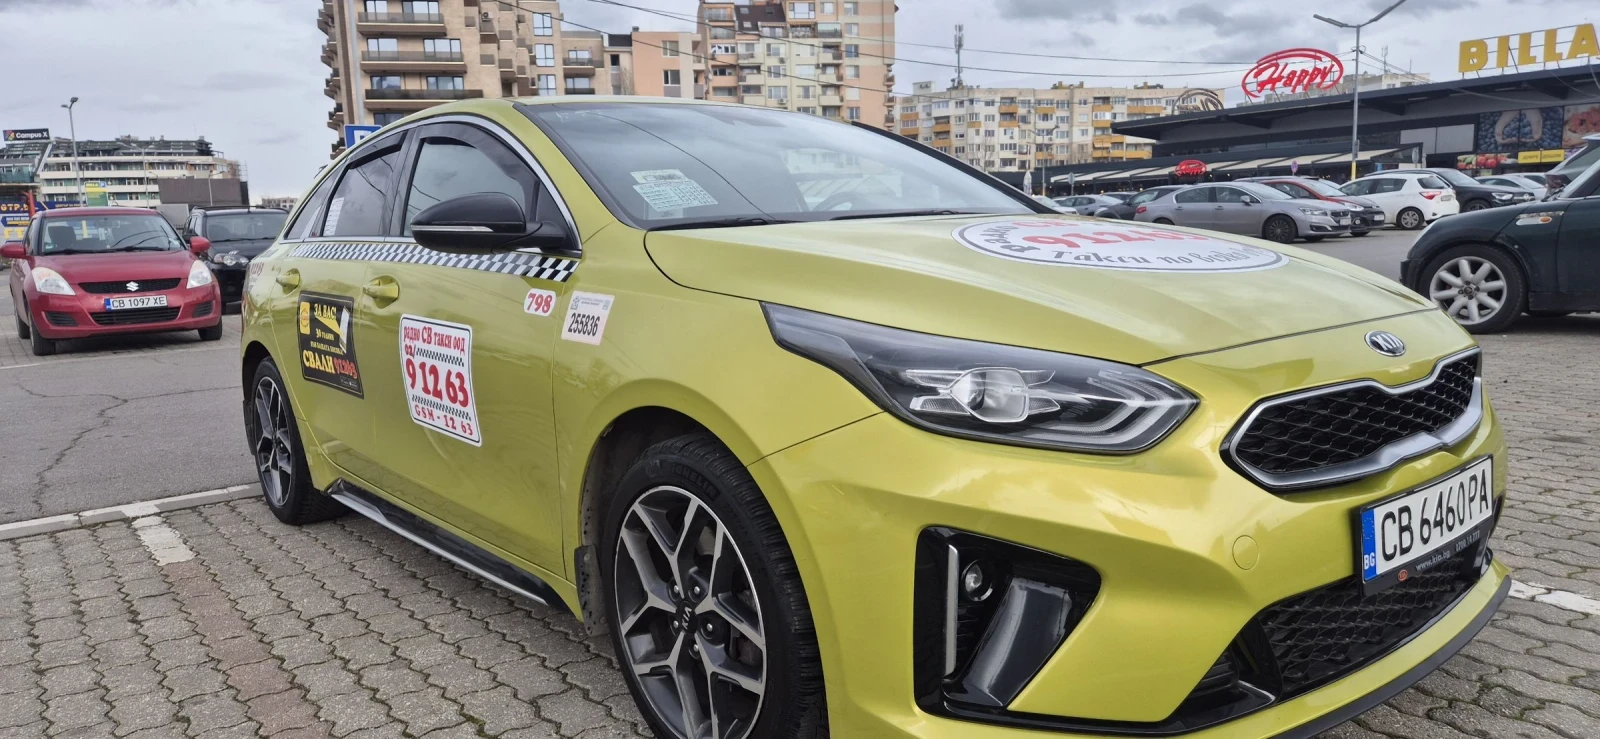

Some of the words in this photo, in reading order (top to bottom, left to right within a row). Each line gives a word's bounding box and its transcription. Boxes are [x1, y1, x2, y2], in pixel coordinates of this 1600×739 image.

[1458, 23, 1600, 73] BILLA
[1252, 61, 1335, 94] Happy
[16, 131, 41, 139] Campus
[112, 299, 125, 308] CB
[128, 297, 150, 307] 1097
[153, 296, 166, 305] XE
[526, 292, 553, 314] 798
[421, 325, 433, 345] СВ
[567, 312, 600, 337] 255836
[414, 404, 435, 422] GSM
[1380, 504, 1414, 562] CB
[1363, 551, 1376, 570] BG
[1415, 549, 1451, 572] www.kia.bg
[681, 606, 693, 630] KIA
